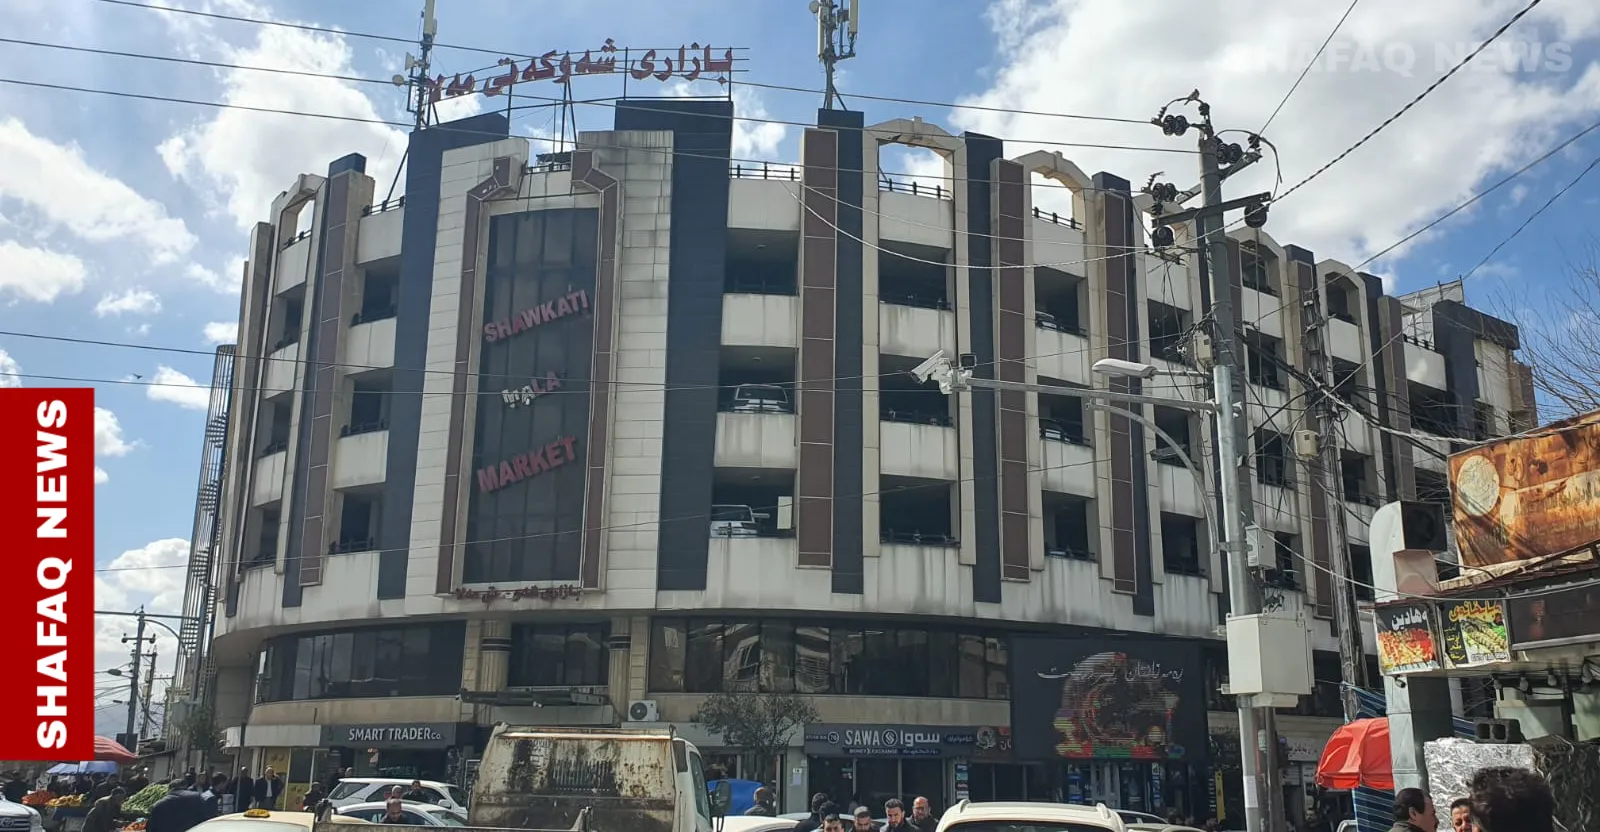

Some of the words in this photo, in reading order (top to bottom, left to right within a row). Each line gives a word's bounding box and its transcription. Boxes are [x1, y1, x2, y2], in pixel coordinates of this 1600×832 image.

[484, 289, 589, 343] SHAWKATI
[477, 435, 577, 493] MARKET
[348, 728, 385, 741] SMART
[388, 727, 431, 741] TRADER
[844, 729, 881, 746] SAWA
